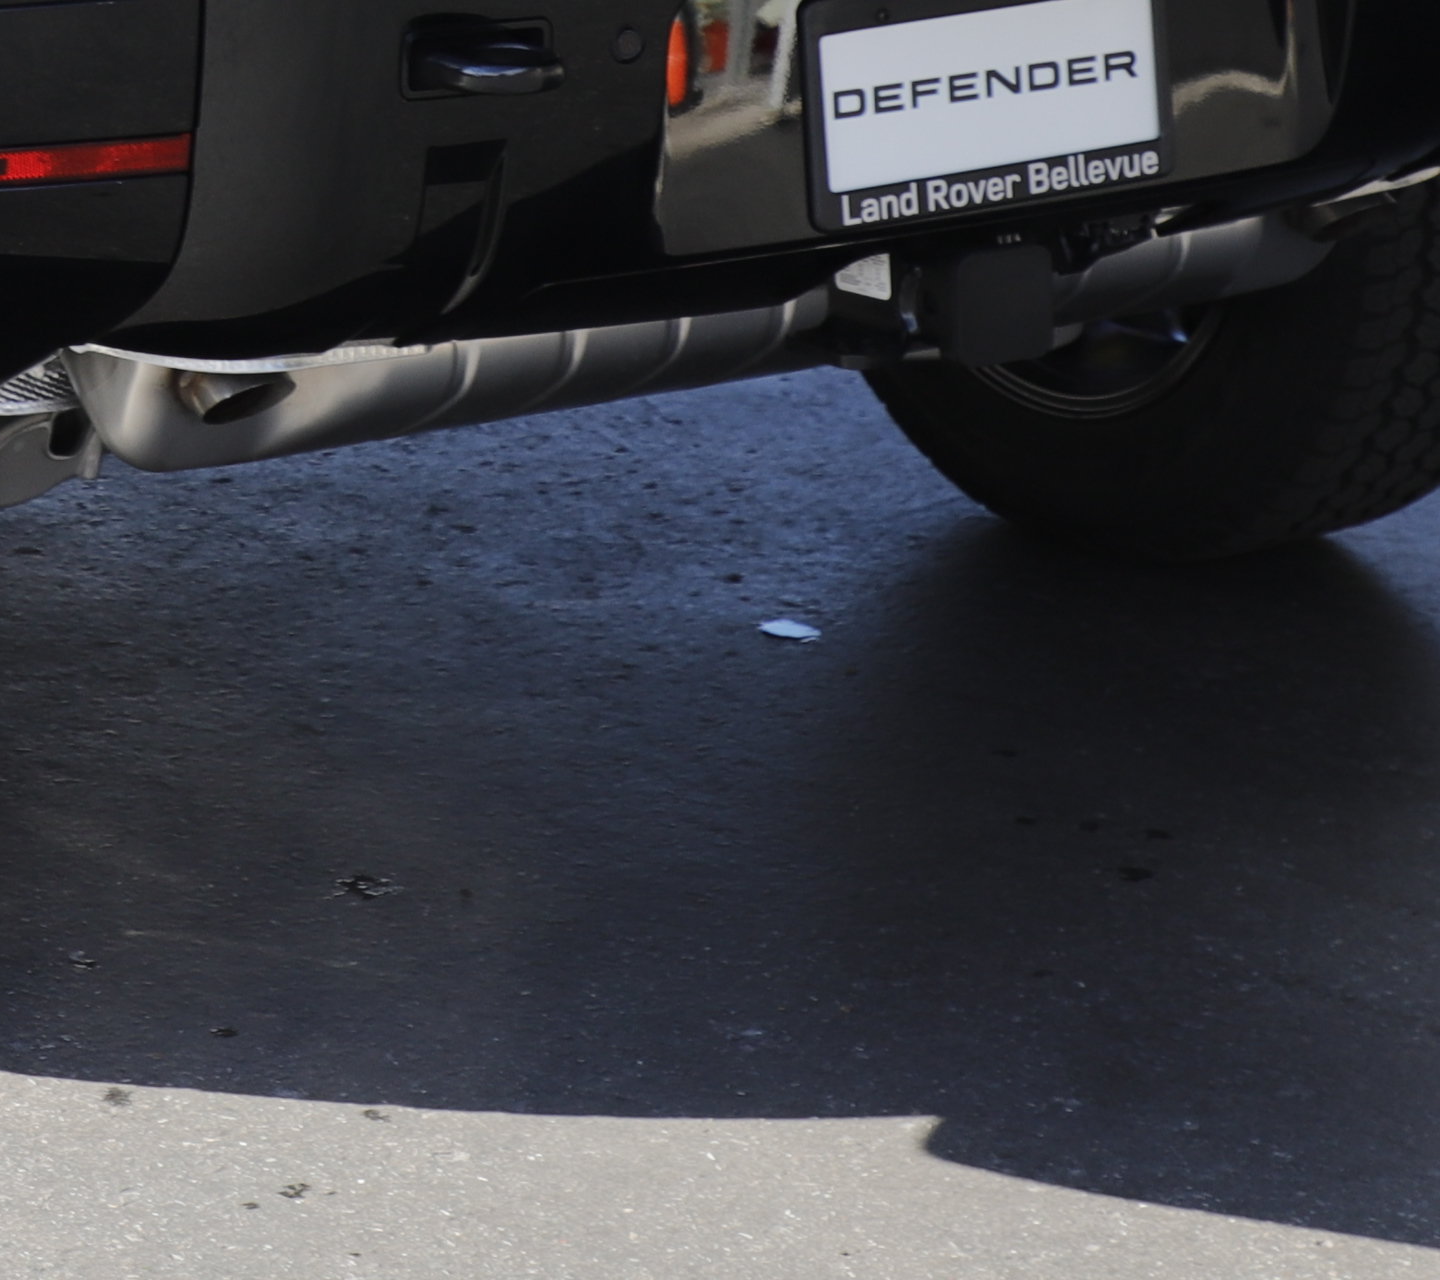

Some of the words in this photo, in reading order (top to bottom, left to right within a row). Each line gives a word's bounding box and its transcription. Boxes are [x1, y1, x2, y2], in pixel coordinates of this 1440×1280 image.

[833, 50, 1138, 120] DEFENDER
[841, 182, 919, 227] Land
[926, 172, 1022, 212] Rover
[1027, 150, 1160, 195] Bellevue
